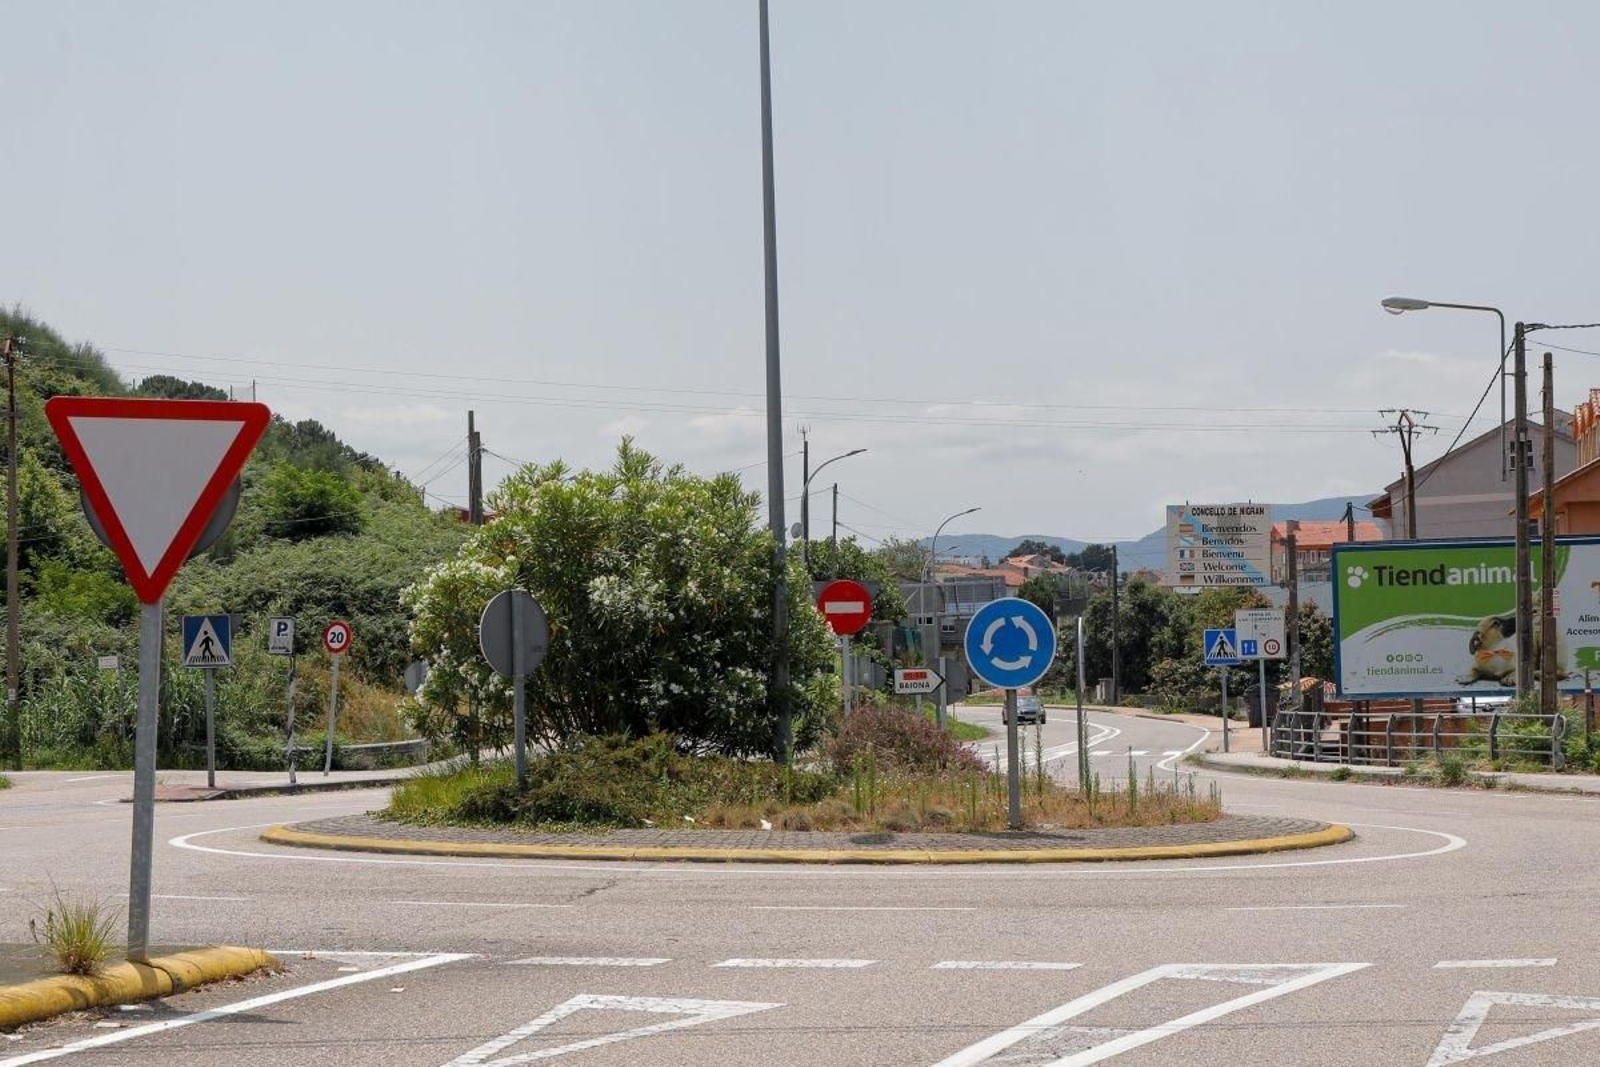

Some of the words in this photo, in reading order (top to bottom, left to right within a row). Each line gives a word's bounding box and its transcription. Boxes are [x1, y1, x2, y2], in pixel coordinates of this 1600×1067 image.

[1192, 507, 1226, 516] CONCELLO
[1228, 507, 1236, 516] DE
[1202, 523, 1257, 532] Bienvenidos
[1202, 537, 1244, 545] Benvidos
[1203, 562, 1246, 571] Welcome
[1203, 575, 1263, 584] Willkommen
[277, 622, 288, 637] P
[330, 632, 344, 643] 20
[1367, 665, 1443, 676] tiendanimal.es
